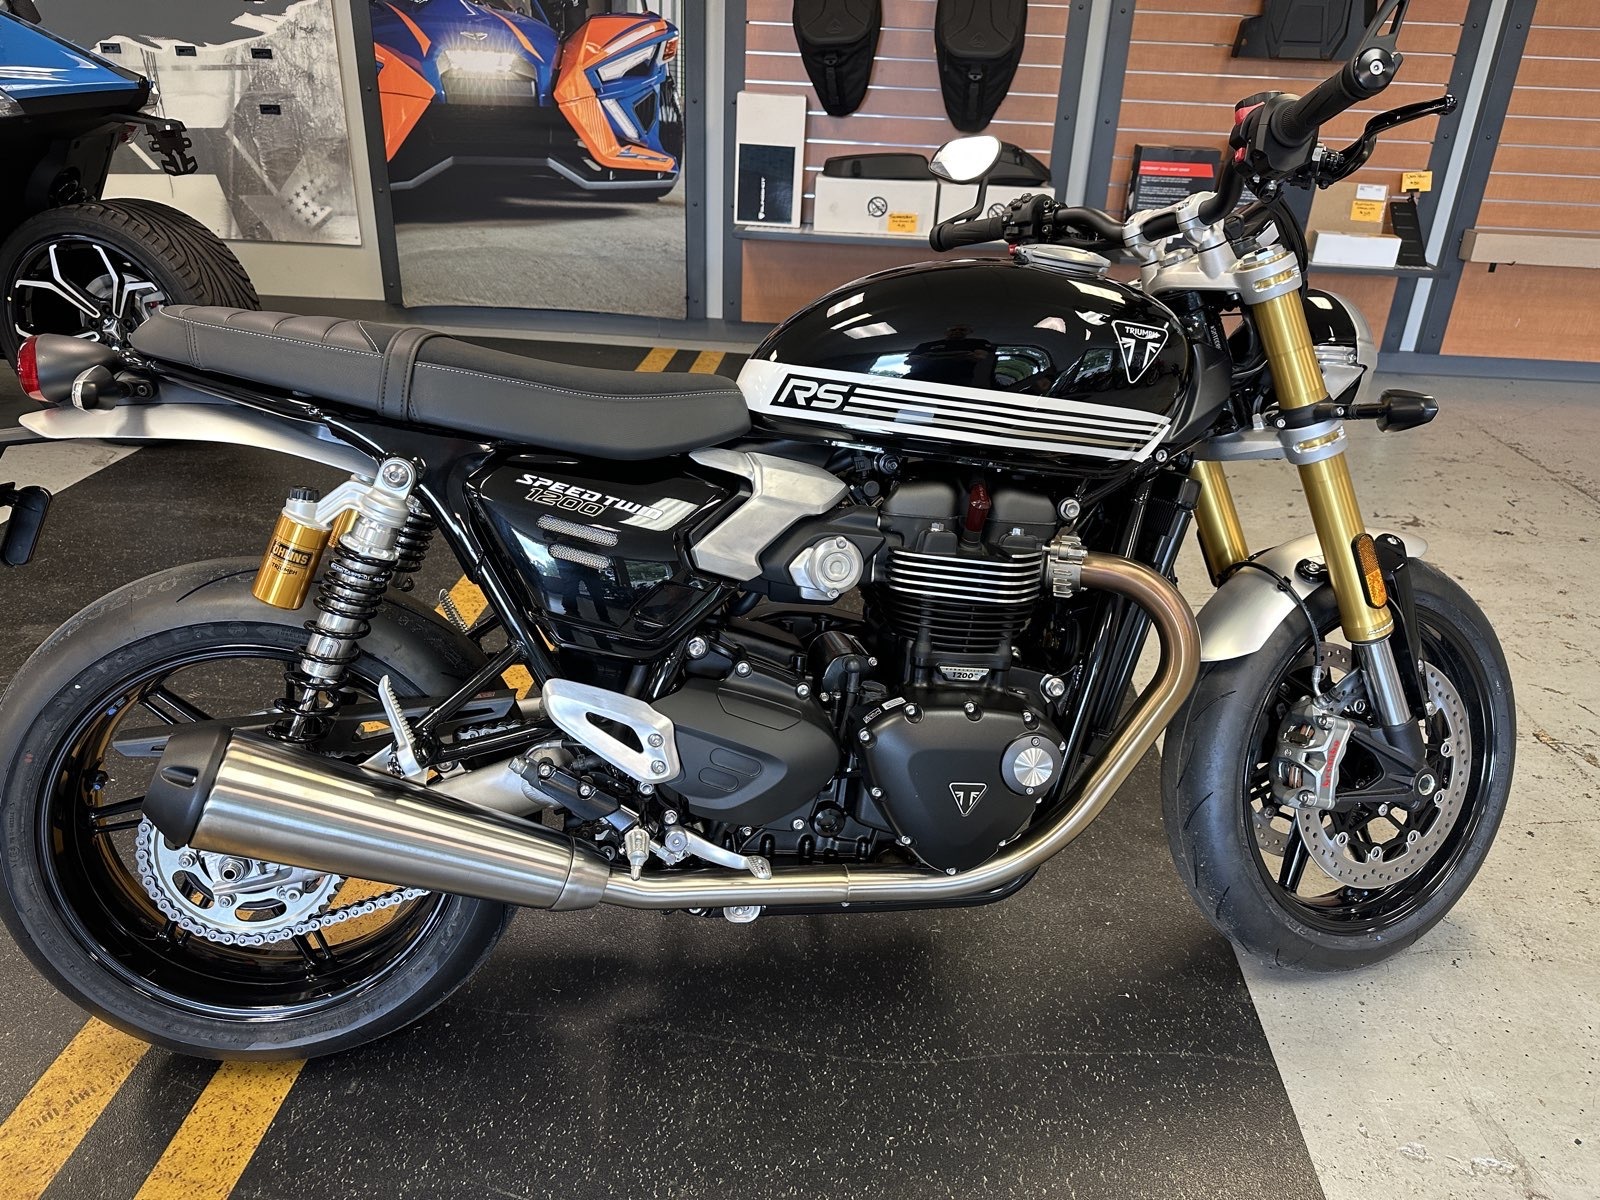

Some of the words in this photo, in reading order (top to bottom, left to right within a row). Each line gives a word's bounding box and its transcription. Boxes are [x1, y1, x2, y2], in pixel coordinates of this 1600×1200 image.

[777, 378, 844, 410] RS
[515, 474, 602, 501] SPEED
[524, 487, 609, 518] 1200
[952, 671, 974, 680] 1200
[1322, 740, 1340, 788] brembo
